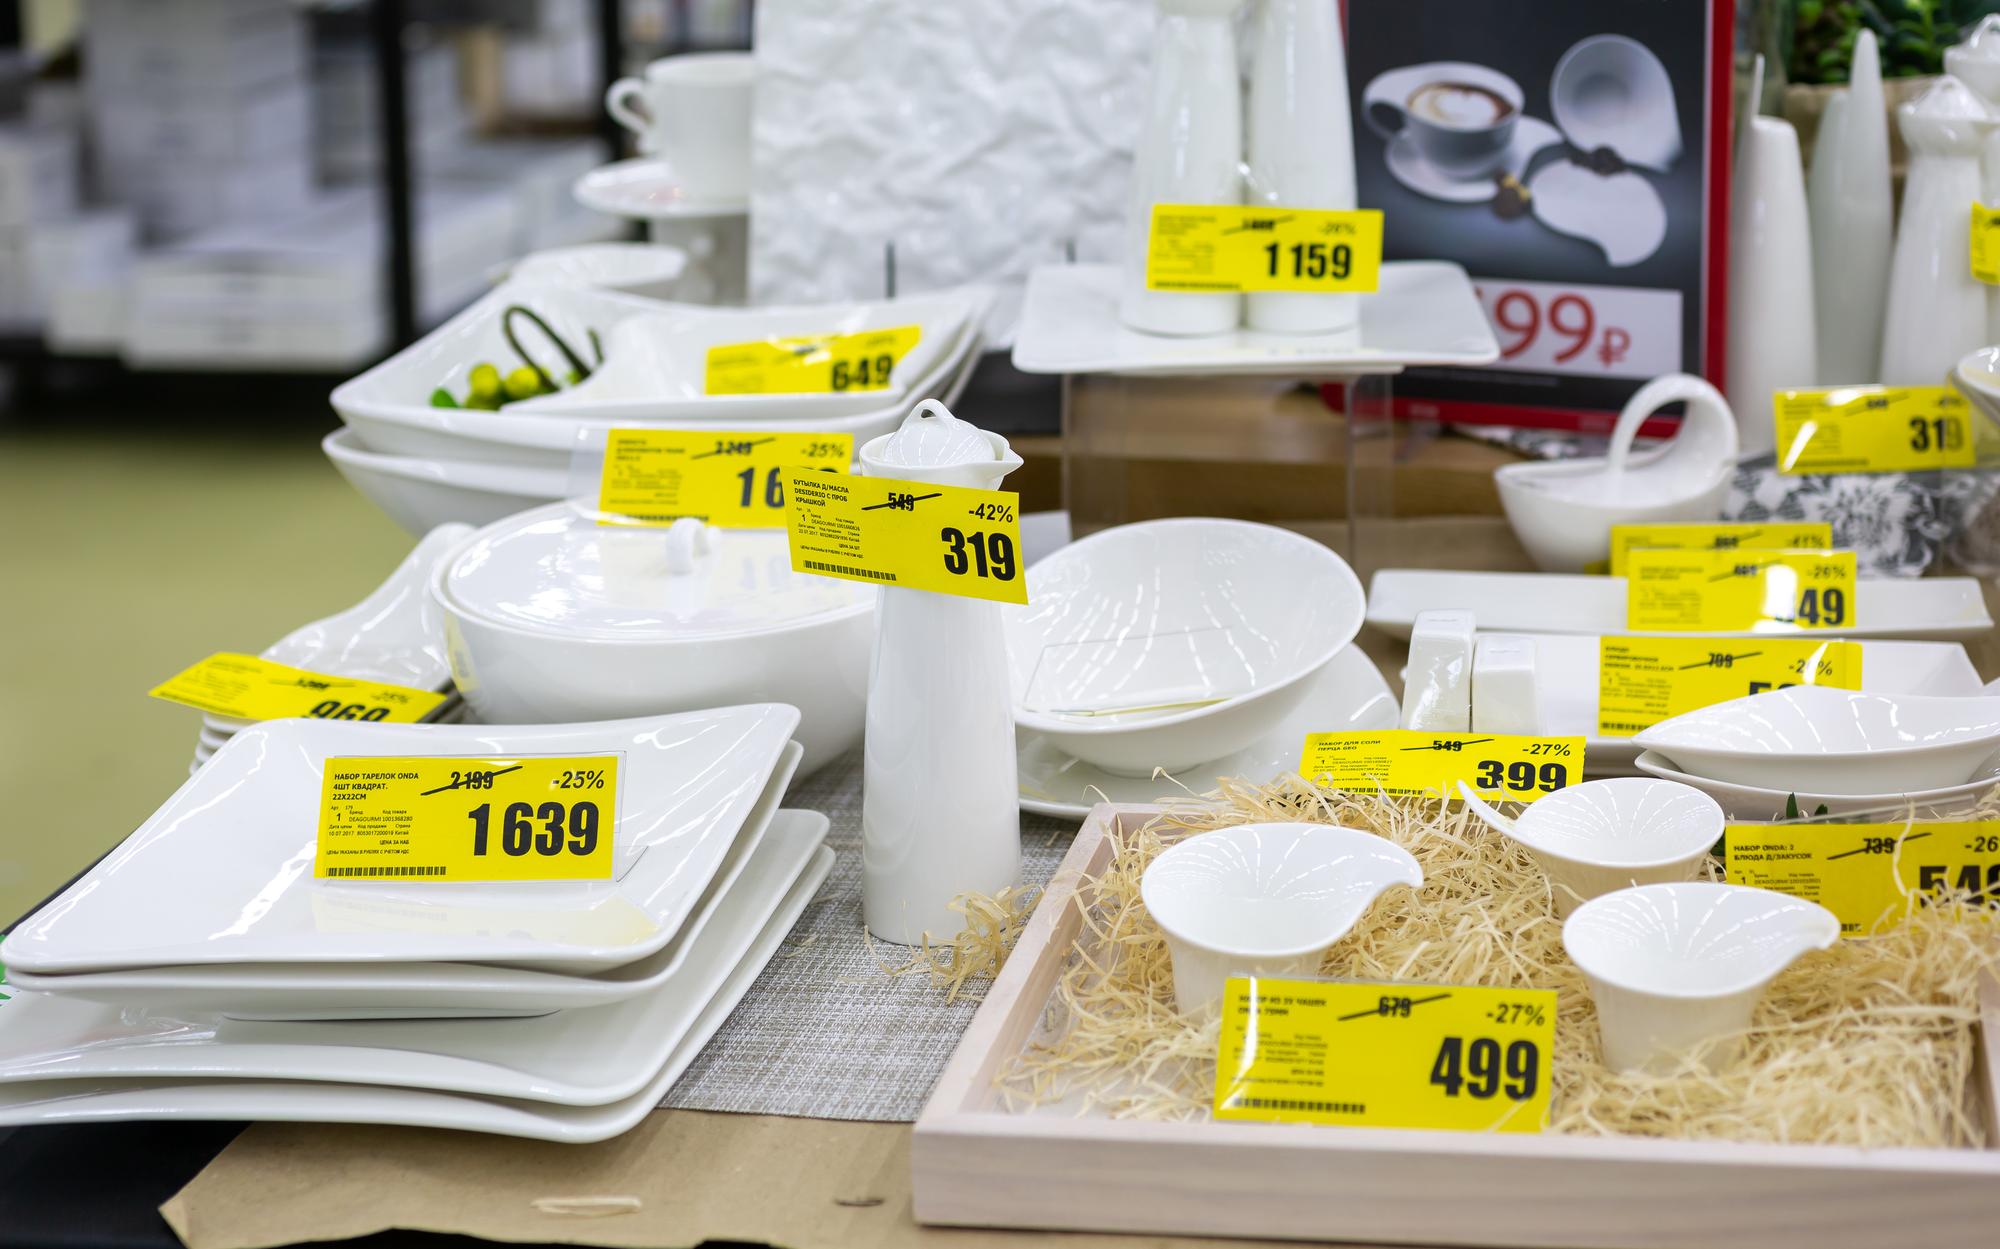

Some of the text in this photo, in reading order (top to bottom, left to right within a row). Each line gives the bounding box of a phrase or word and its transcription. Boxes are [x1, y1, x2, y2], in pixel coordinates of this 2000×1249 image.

[832, 354, 893, 391] 649
[793, 479, 820, 489] БУТЫЛКА
[795, 496, 826, 507] КРЫШКОЙ
[888, 491, 915, 512] 549
[968, 503, 1014, 523] -42%
[941, 526, 1016, 582] 319
[1788, 658, 1833, 676] -2%
[1433, 740, 1463, 752] 549
[1522, 743, 1571, 757] -27%
[552, 770, 605, 789] -25%
[1476, 760, 1567, 792] 399
[352, 783, 389, 791] КВАДРАТ.
[336, 812, 341, 821] 1
[1486, 1003, 1545, 1027] -27%
[1429, 1036, 1540, 1101] 499
